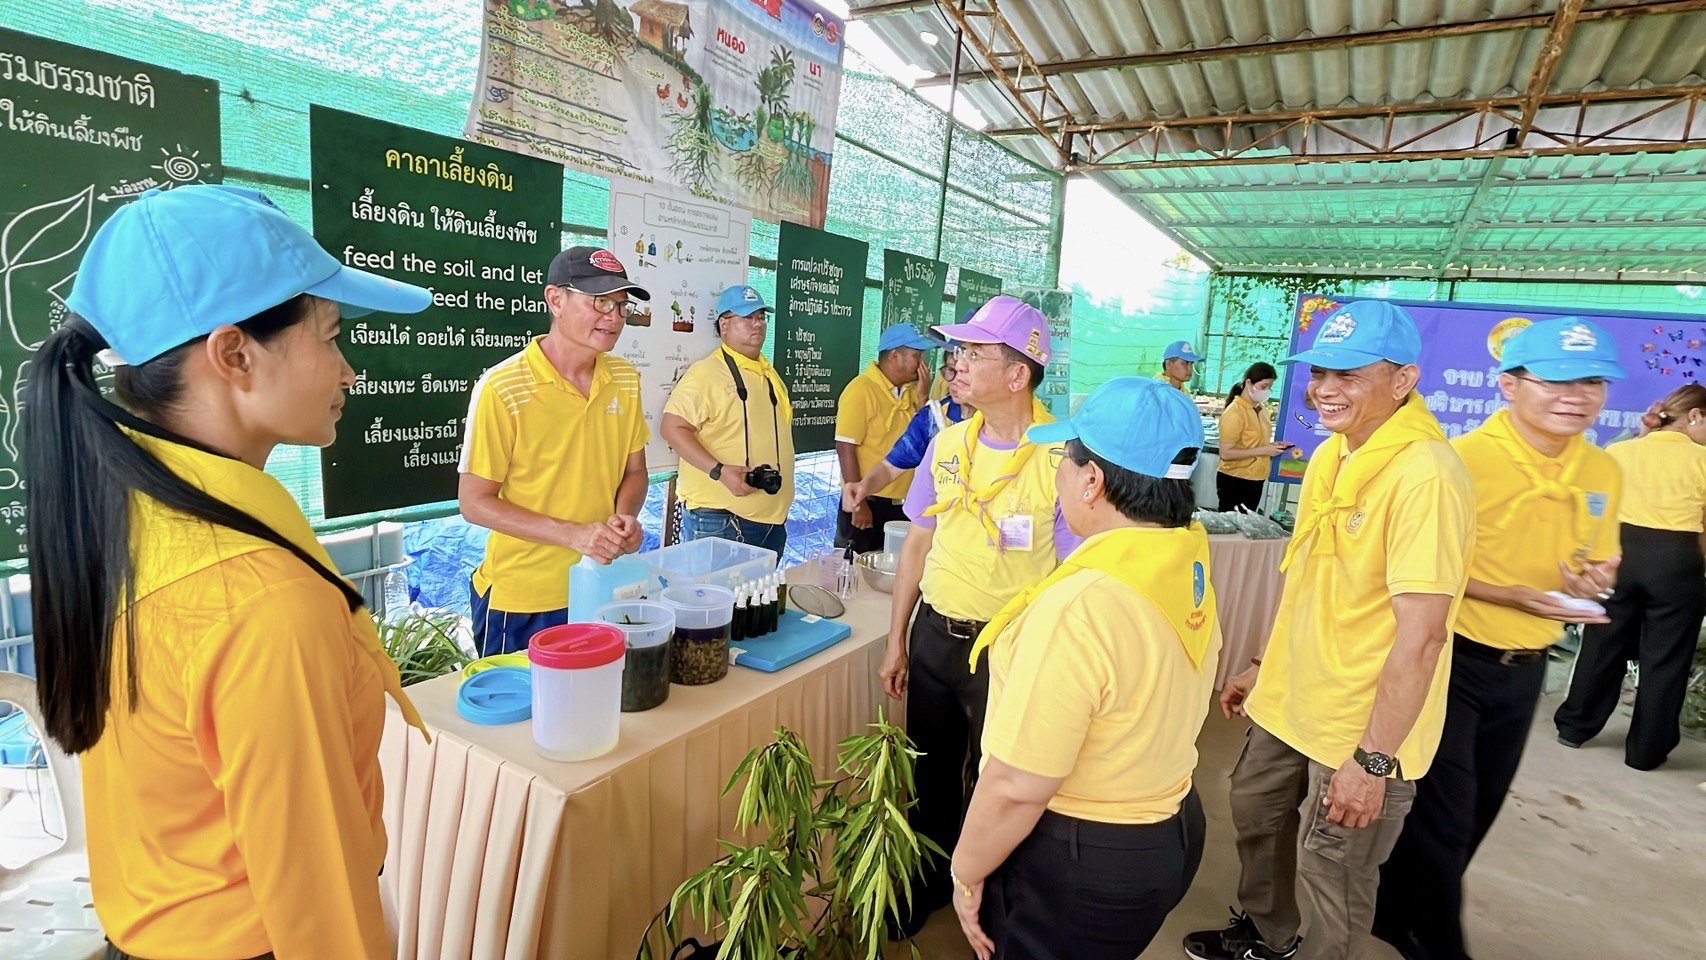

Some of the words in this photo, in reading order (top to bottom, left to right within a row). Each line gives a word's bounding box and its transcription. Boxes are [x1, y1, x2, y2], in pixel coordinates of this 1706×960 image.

[716, 27, 747, 55] หนอง
[809, 62, 822, 78] นา
[0, 98, 143, 151] ให้ดินเลี้ยงพืช
[385, 146, 513, 192] คาถาเลี้ยงดิน
[352, 187, 425, 229] เลี้ยงดิน
[430, 206, 538, 245] ให้ดินเลี้ยงพืช
[343, 245, 395, 270] feed
[402, 253, 437, 274] the
[443, 259, 476, 278] soil
[481, 265, 515, 282] and
[521, 266, 544, 285] let
[475, 290, 505, 311] the
[511, 296, 550, 316] plan
[823, 301, 830, 315] 5
[830, 299, 853, 317] ประการ
[350, 323, 411, 345] เจียมได๋
[416, 326, 466, 346] ออยได๋
[787, 330, 792, 341] 1.
[795, 326, 816, 346] ปรัชญา
[786, 348, 792, 359] 2.
[785, 366, 791, 376] 3.
[364, 416, 458, 444] เลี้ยงแม่ธรณี
[403, 442, 464, 468] เลี้ยงแม่
